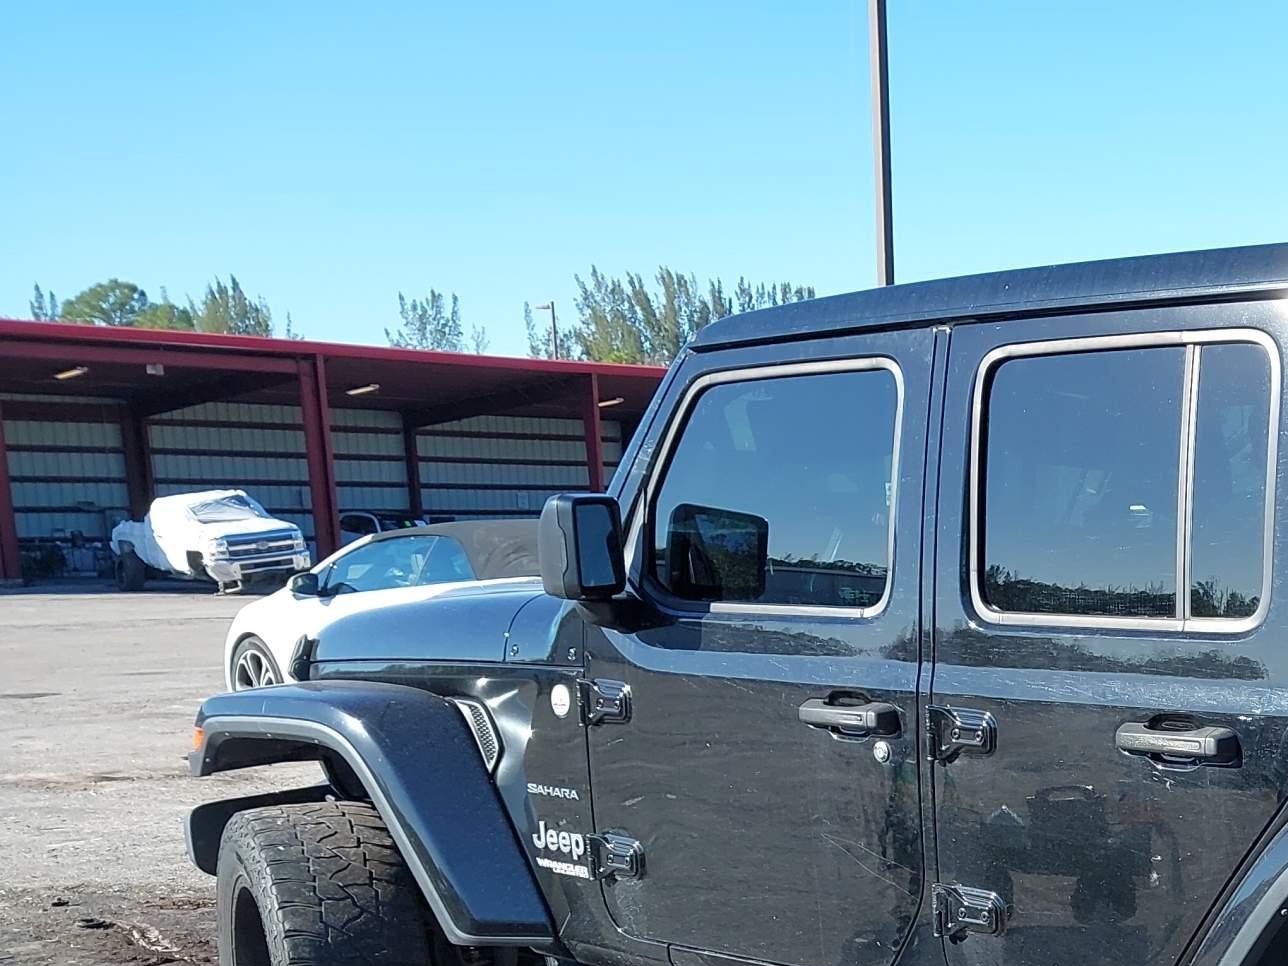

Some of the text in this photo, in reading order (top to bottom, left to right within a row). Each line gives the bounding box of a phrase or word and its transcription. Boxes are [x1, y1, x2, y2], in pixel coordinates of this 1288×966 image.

[527, 783, 579, 801] SAHARA
[532, 821, 584, 860] Jeep
[536, 857, 588, 874] WRANGLER
